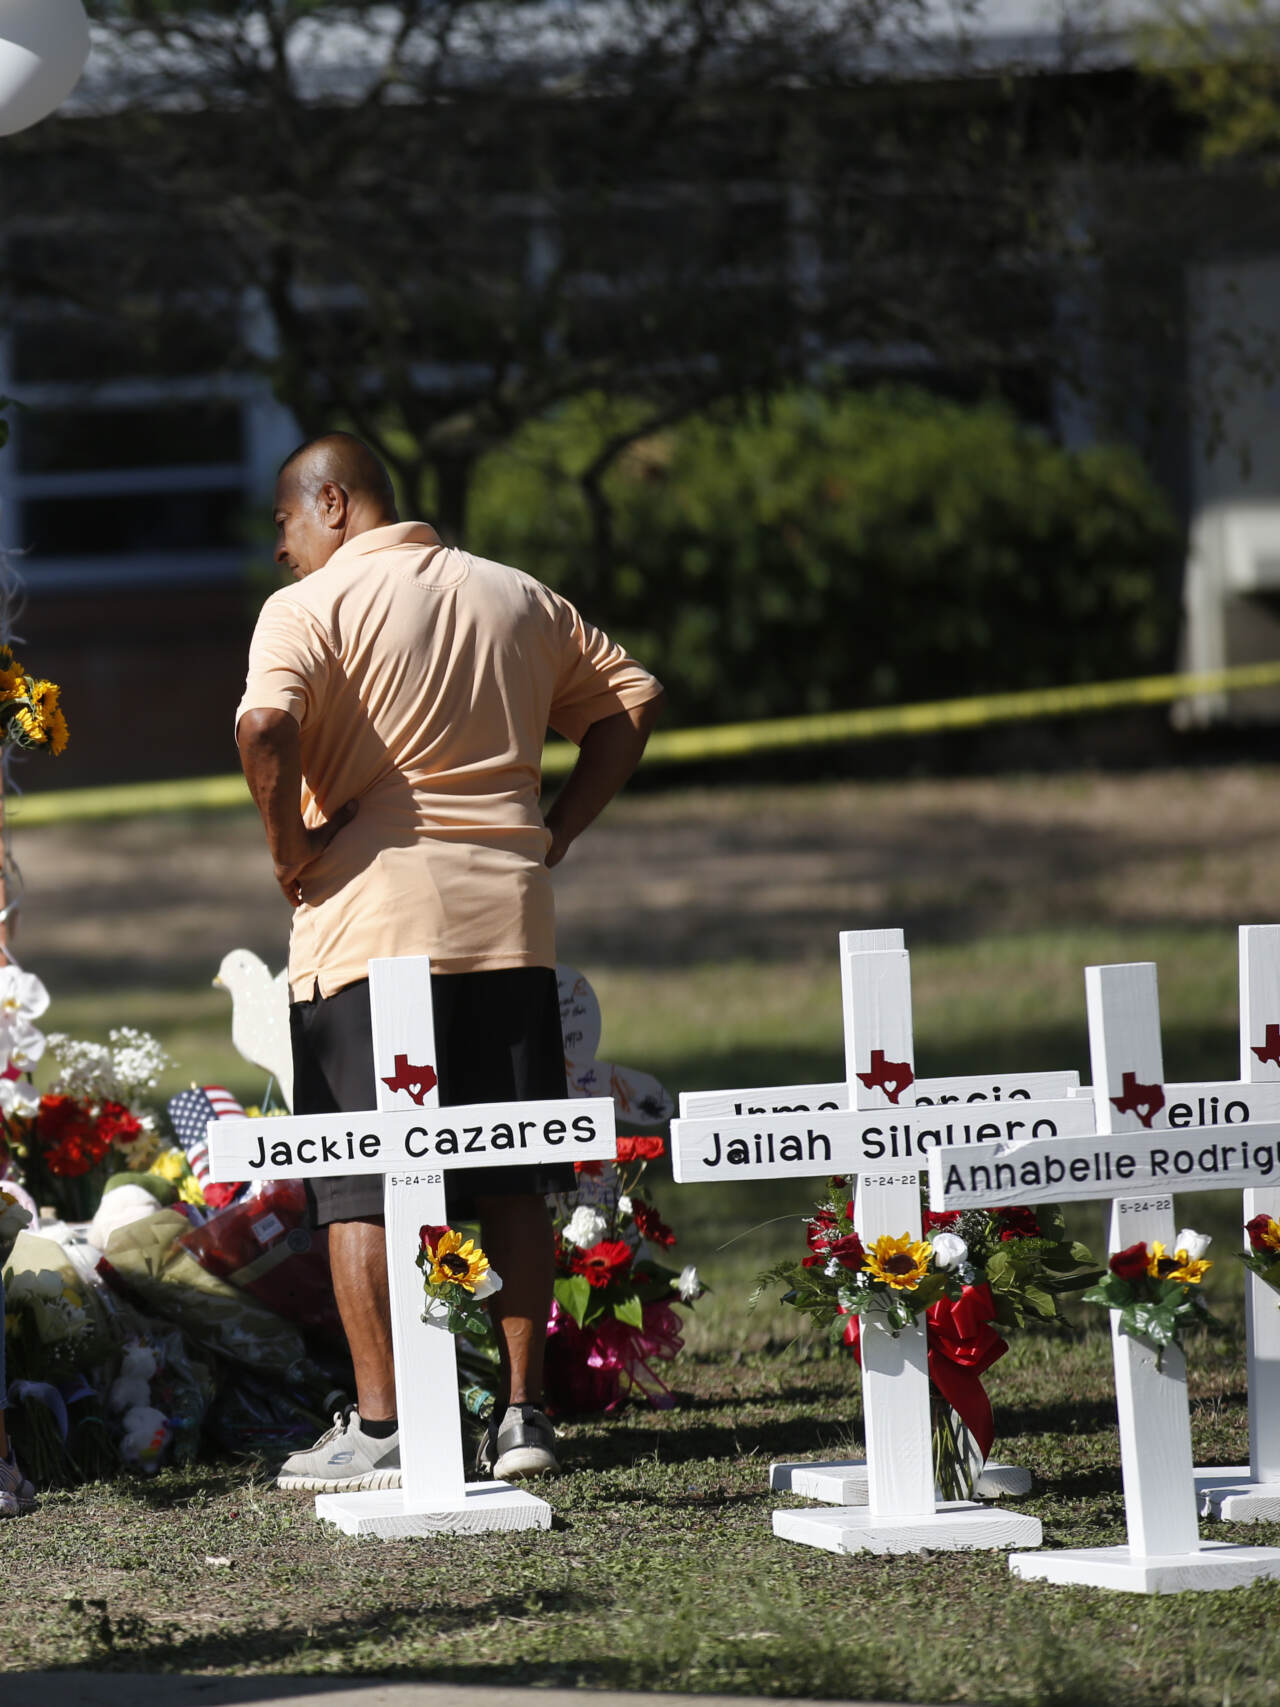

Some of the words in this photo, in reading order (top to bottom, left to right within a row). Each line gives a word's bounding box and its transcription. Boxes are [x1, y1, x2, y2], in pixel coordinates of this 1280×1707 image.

[1168, 1096, 1250, 1129] elio
[248, 1131, 382, 1168] Jackie
[404, 1114, 597, 1159] Cazares
[702, 1129, 832, 1167] Jailah
[391, 1174, 442, 1187] 5-24-22
[864, 1175, 917, 1187] 5-24-22
[943, 1151, 1136, 1194] Annabelle
[1150, 1141, 1280, 1178] Rodrig
[1120, 1199, 1171, 1215] 5-24-22
